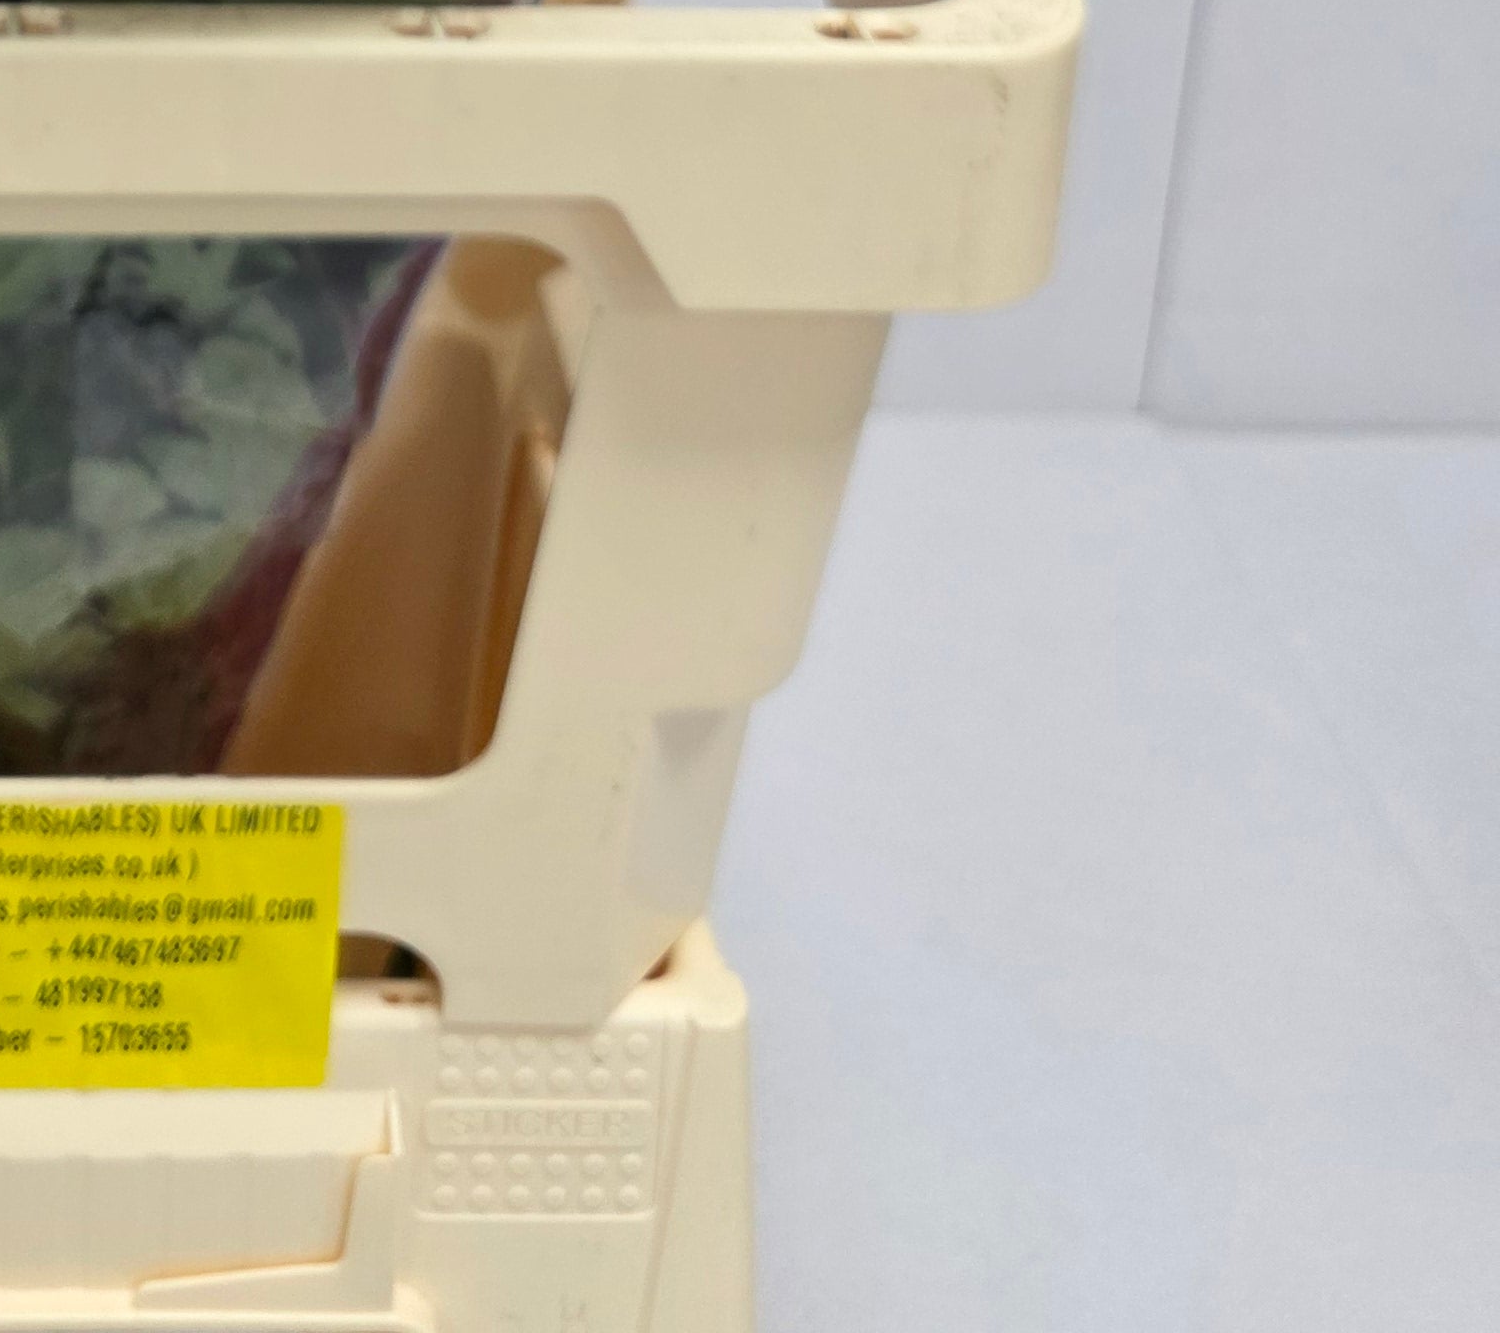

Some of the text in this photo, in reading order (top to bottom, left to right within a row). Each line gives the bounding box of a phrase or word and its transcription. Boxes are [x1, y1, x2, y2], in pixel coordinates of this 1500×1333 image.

[170, 804, 206, 835] UK
[215, 804, 323, 836] LIMITED
[446, 1109, 633, 1139] STICKER
